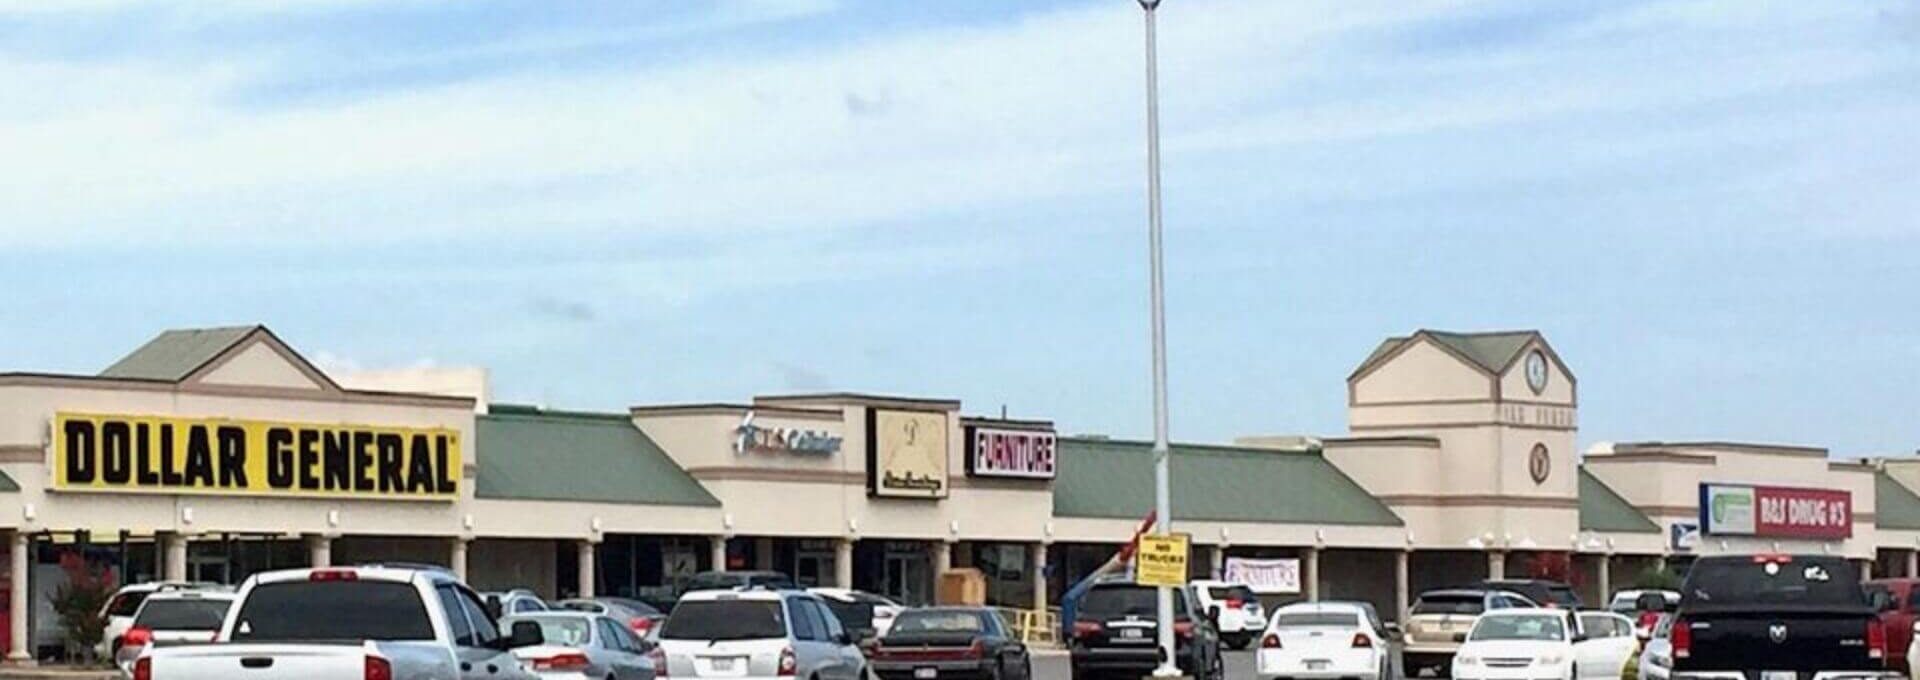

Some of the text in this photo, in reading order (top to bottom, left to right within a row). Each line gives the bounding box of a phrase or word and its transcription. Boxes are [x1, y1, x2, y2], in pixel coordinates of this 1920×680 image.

[65, 420, 456, 494] DOLLAR GENERAL
[977, 431, 1053, 473] FURNITURE
[1760, 496, 1786, 524] B&S
[1788, 498, 1826, 526] DRUG
